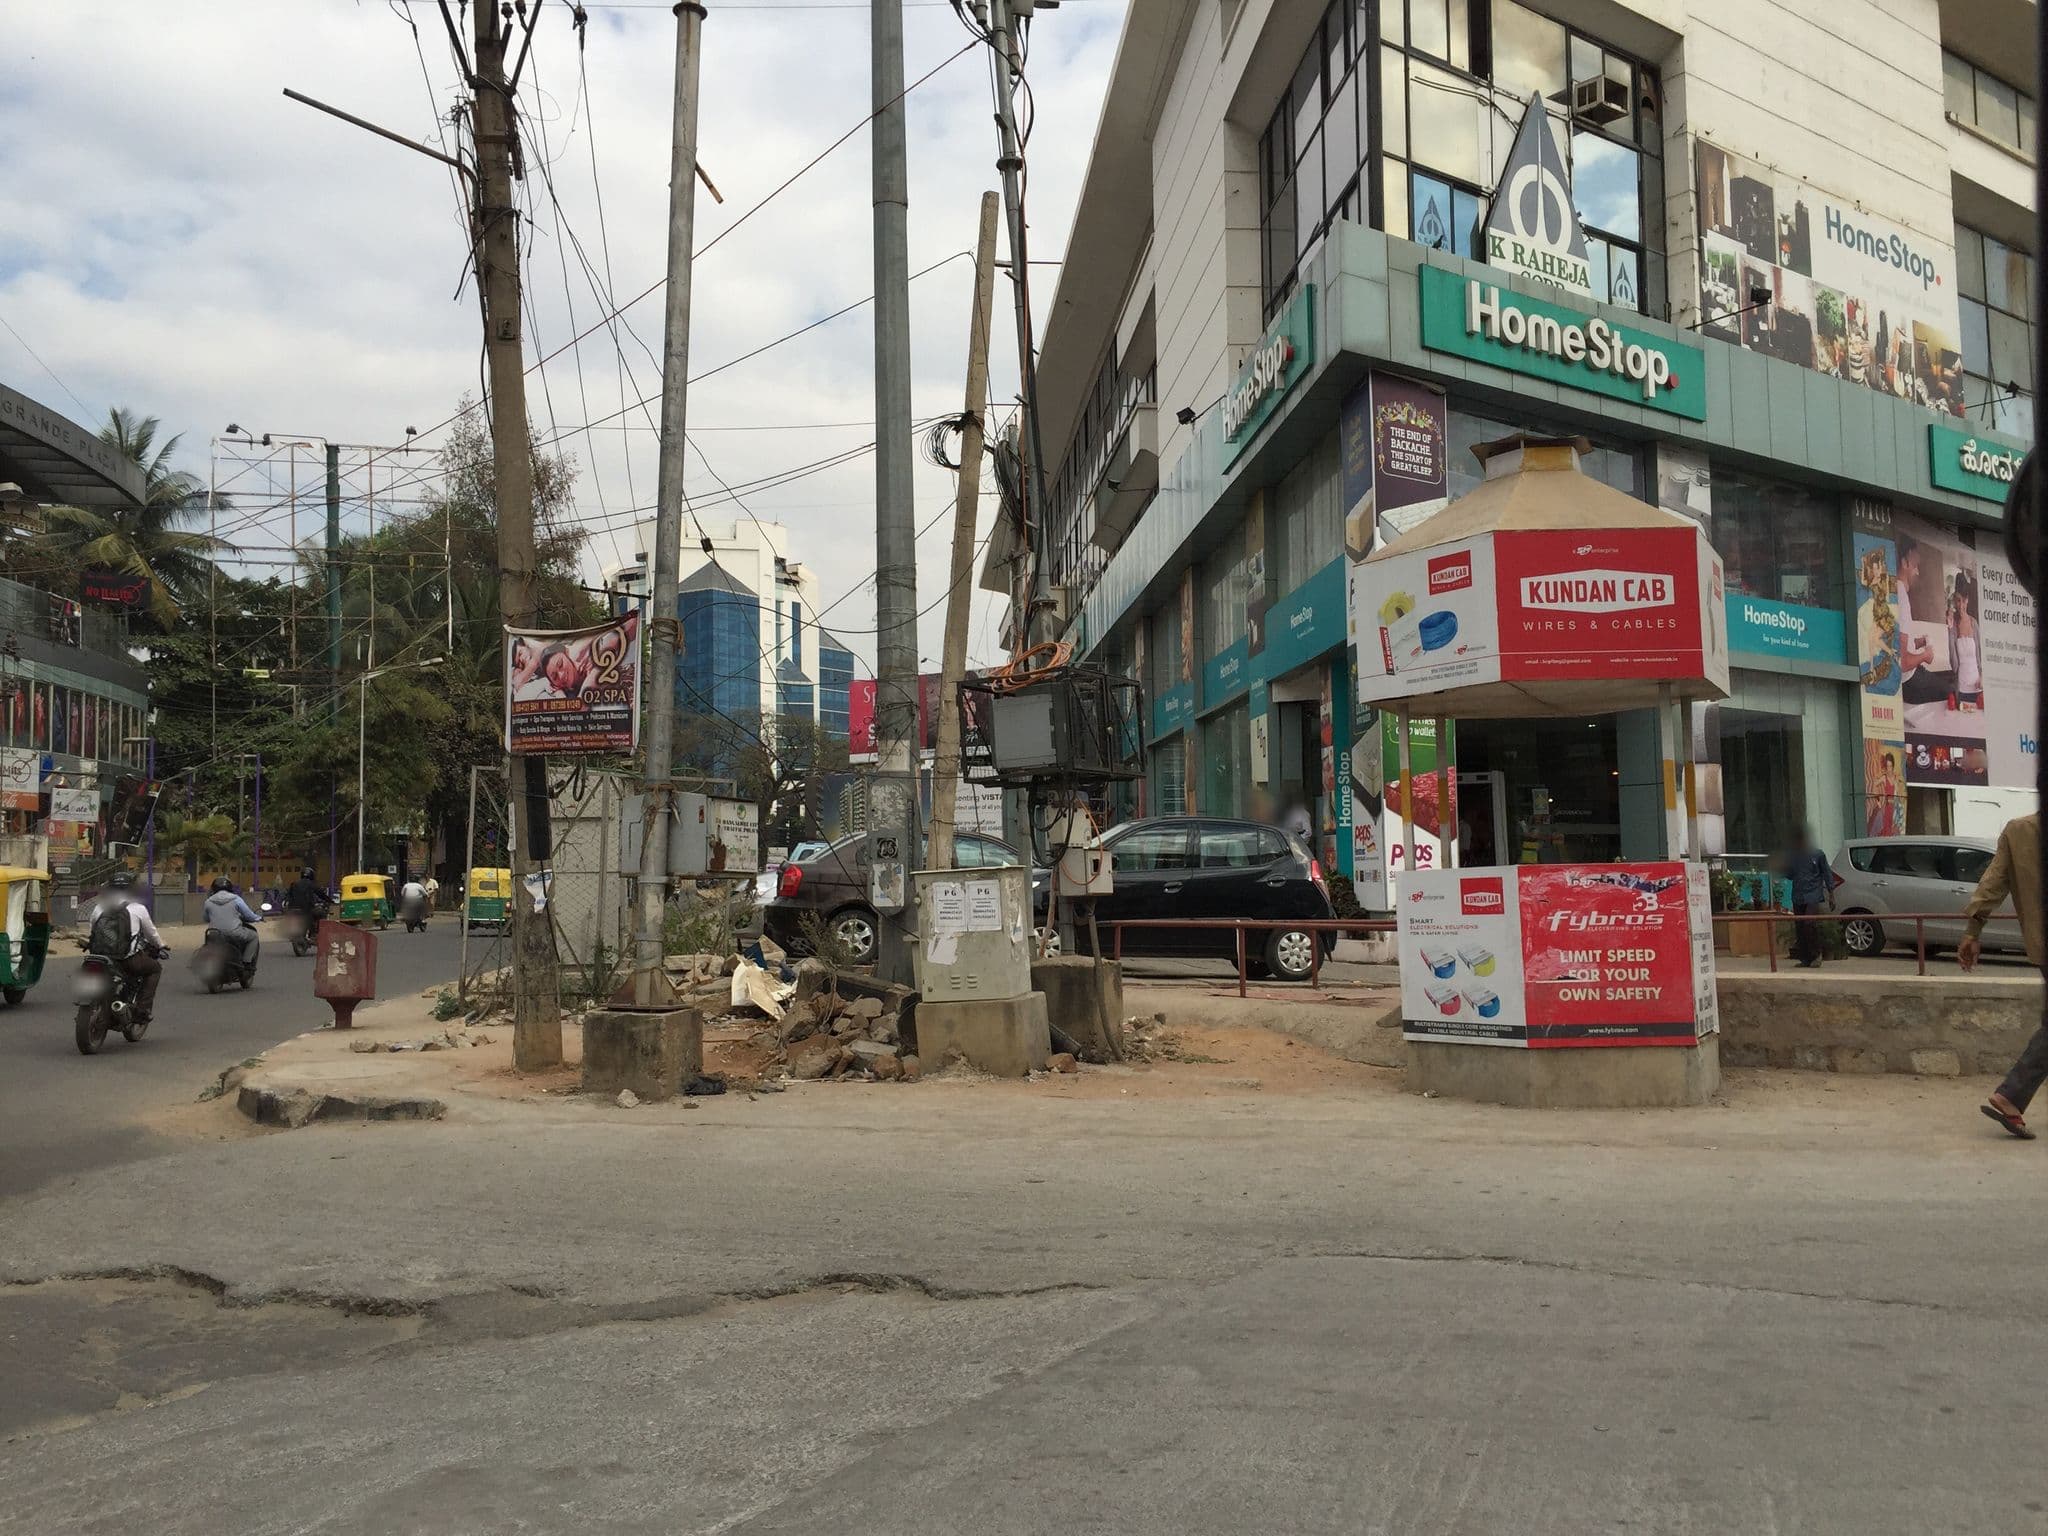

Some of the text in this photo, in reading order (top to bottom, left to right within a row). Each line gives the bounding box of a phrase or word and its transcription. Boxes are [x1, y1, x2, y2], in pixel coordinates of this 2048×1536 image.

[1490, 235, 1506, 260] K
[1512, 242, 1592, 288] RAHEJA
[2, 400, 71, 444] GRANDE
[1390, 427, 1431, 443] THE END OF
[1391, 450, 1432, 466] THE START OF
[1391, 461, 1411, 472] GREAT
[1981, 565, 2003, 586] Every
[1528, 579, 1666, 604] KUNDAN CAB
[1983, 586, 2030, 607] home, from
[1984, 608, 2010, 624] corner
[2012, 612, 2020, 625] of
[1523, 619, 1677, 631] WIRES & CABLES
[604, 689, 628, 703] SPA
[1338, 751, 1352, 827] HomeStop
[1466, 894, 1499, 903] KUNDAN CAB
[1559, 949, 1656, 963] LIMIT SPEED
[1568, 968, 1650, 982] FOR YOUR
[1559, 987, 1662, 1001] OWN SAFETY
